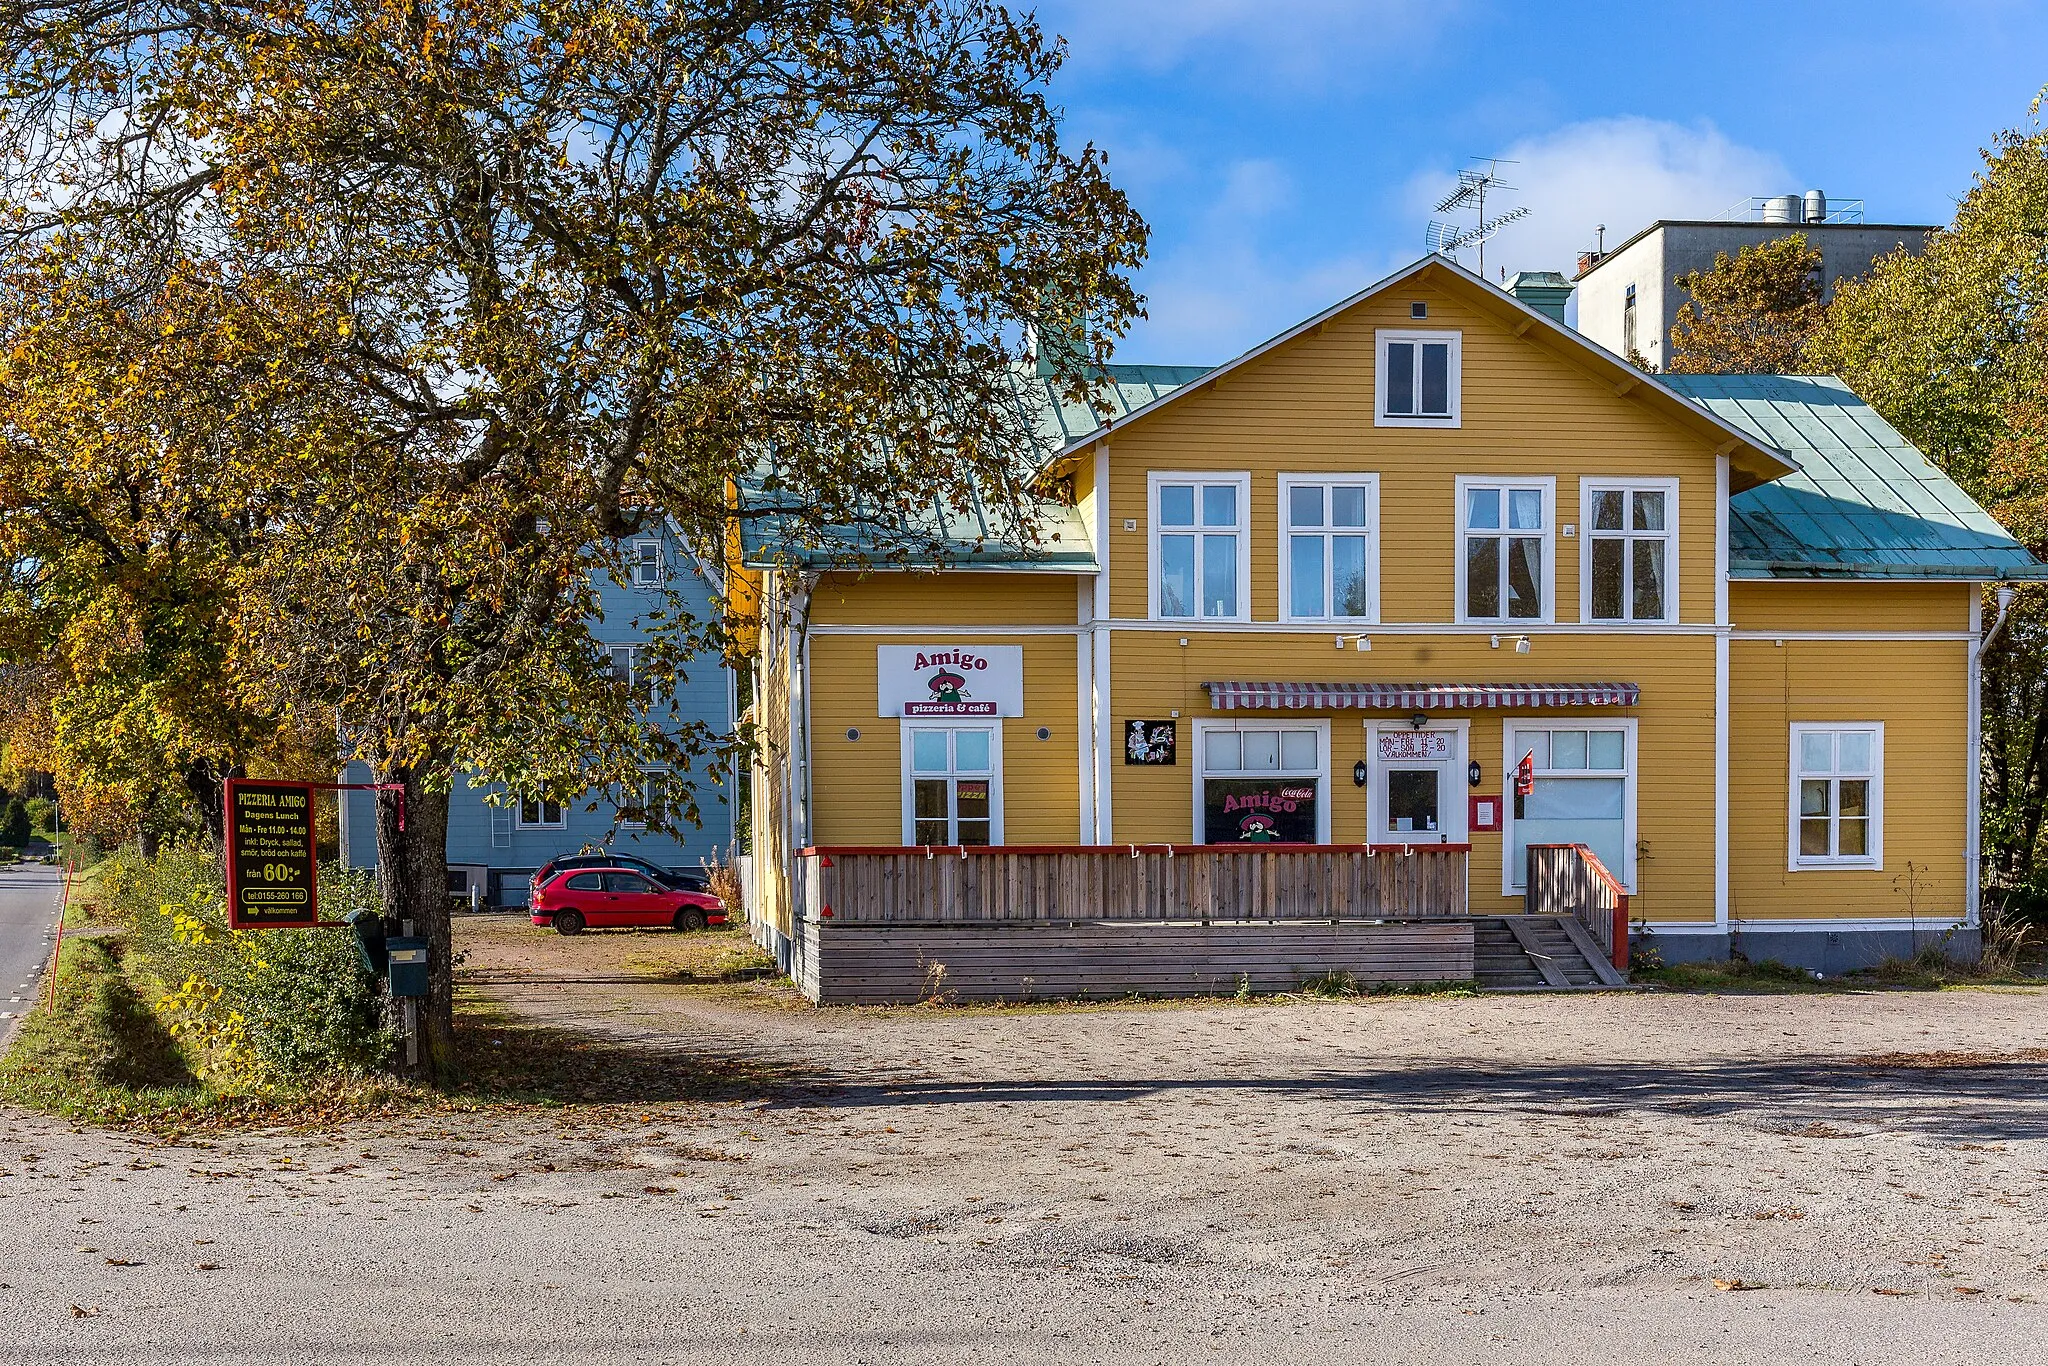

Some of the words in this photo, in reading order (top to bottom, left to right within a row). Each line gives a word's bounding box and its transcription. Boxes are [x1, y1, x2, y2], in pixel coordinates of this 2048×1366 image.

[914, 649, 987, 670] Amigo
[912, 704, 954, 713] pizzeria
[956, 704, 966, 712] &
[968, 703, 990, 712] café
[238, 793, 276, 807] PIZZERIA
[279, 795, 306, 808] AMIGO
[1224, 791, 1297, 813] Amigo
[245, 811, 274, 820] Dagens
[276, 812, 299, 820] Lunch
[240, 824, 253, 833] Mån
[258, 826, 268, 834] Fre
[269, 826, 285, 834] 11.00
[290, 827, 307, 835] 14.00
[260, 838, 280, 847] Dryck,
[282, 839, 304, 847] sallad,
[241, 849, 259, 857] smör,
[261, 849, 276, 857] bröd
[247, 869, 261, 878] från
[264, 864, 301, 881] 60:-
[291, 892, 304, 900] 166
